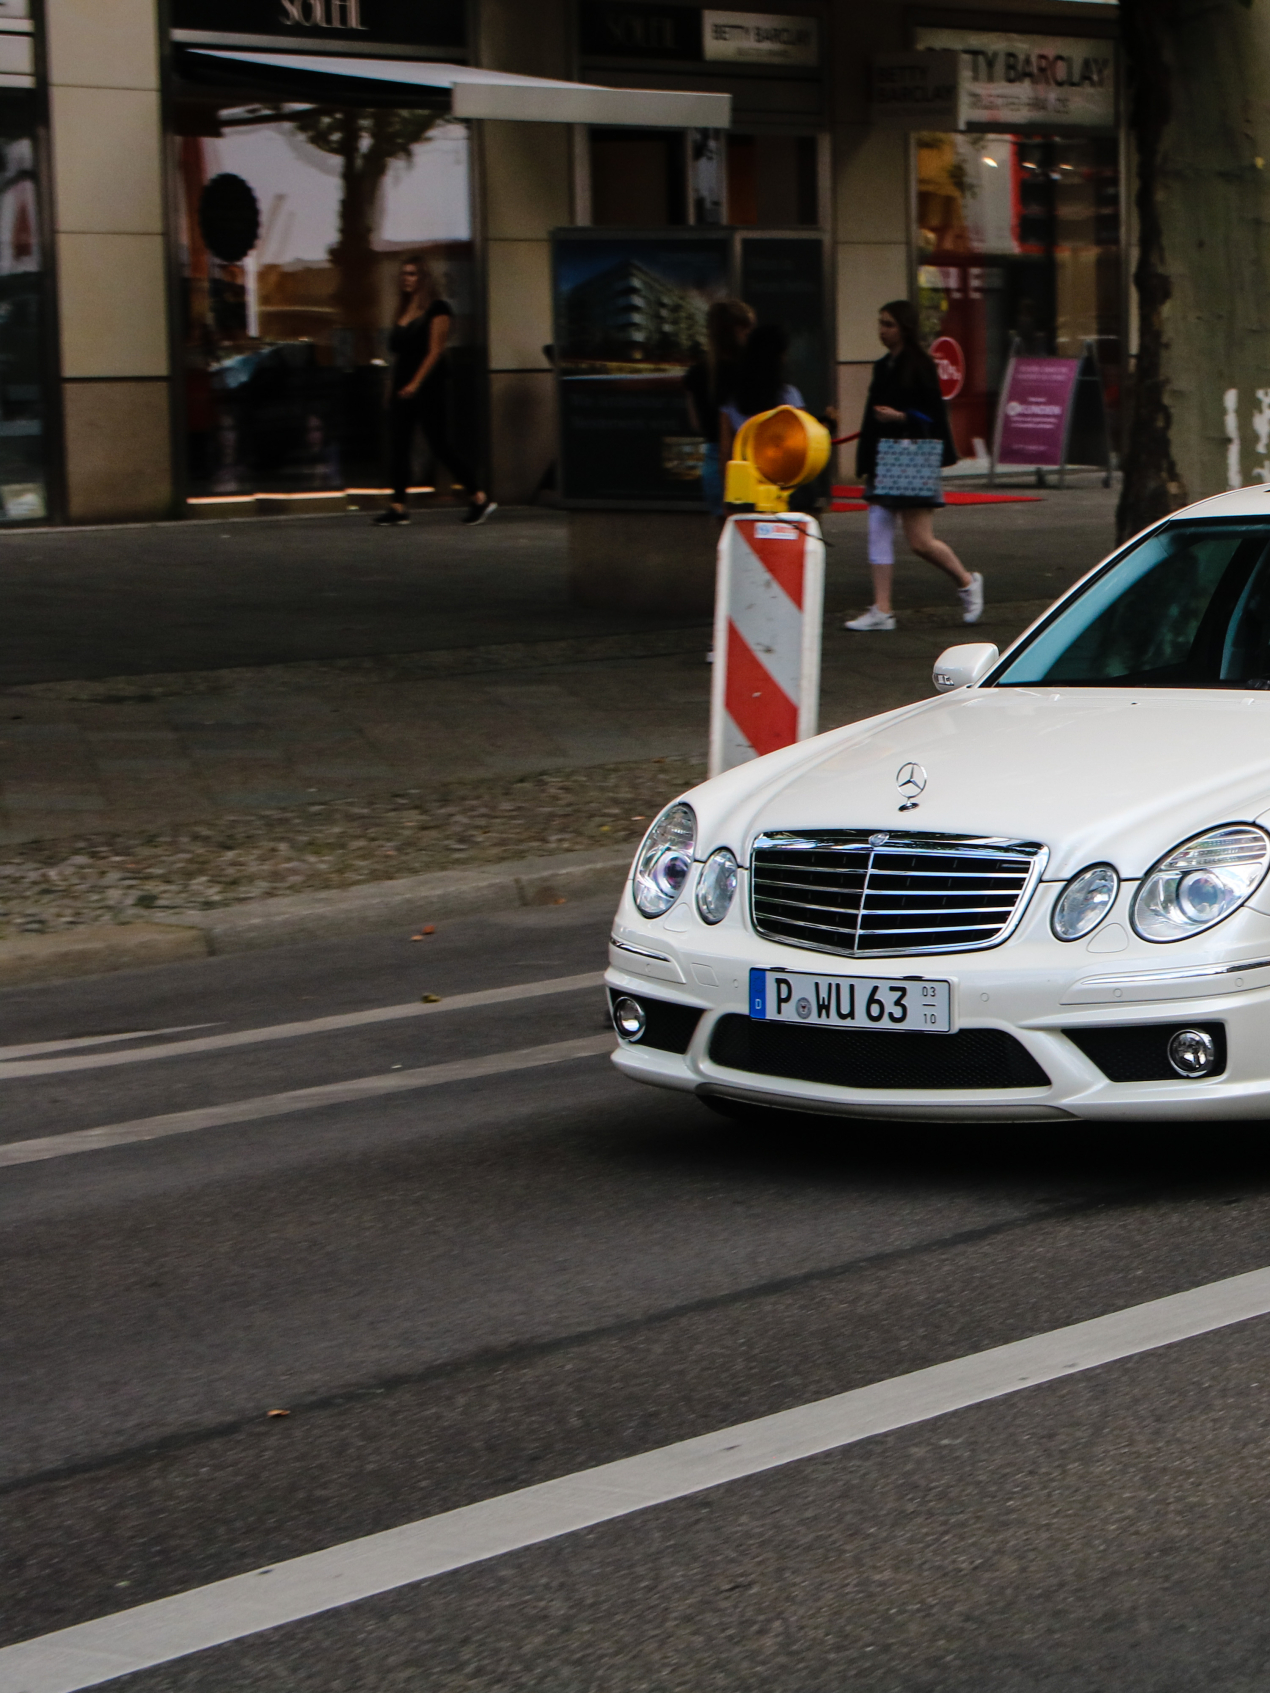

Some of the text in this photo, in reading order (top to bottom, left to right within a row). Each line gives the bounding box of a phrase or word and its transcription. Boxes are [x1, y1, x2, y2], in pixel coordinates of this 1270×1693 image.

[1003, 51, 1110, 87] BARCLAY
[754, 977, 936, 1024] D P WU 63 03
[923, 1013, 937, 1025] 10
